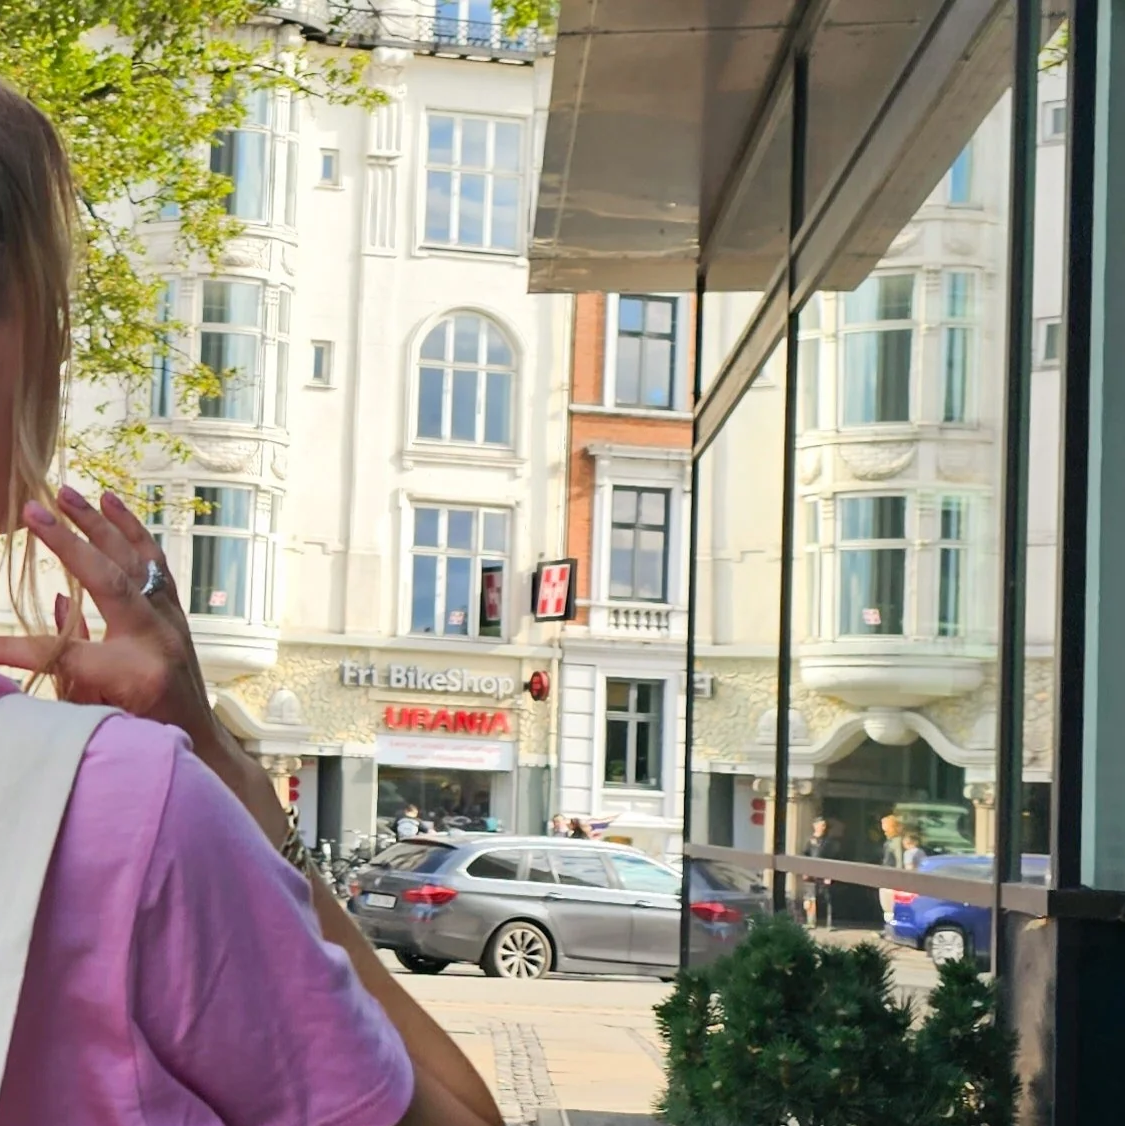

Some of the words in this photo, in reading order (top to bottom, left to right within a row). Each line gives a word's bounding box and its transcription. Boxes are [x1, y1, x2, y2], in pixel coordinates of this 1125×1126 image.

[342, 660, 378, 686] Fri
[389, 664, 515, 698] BikeShop
[384, 706, 512, 735] URANIA
